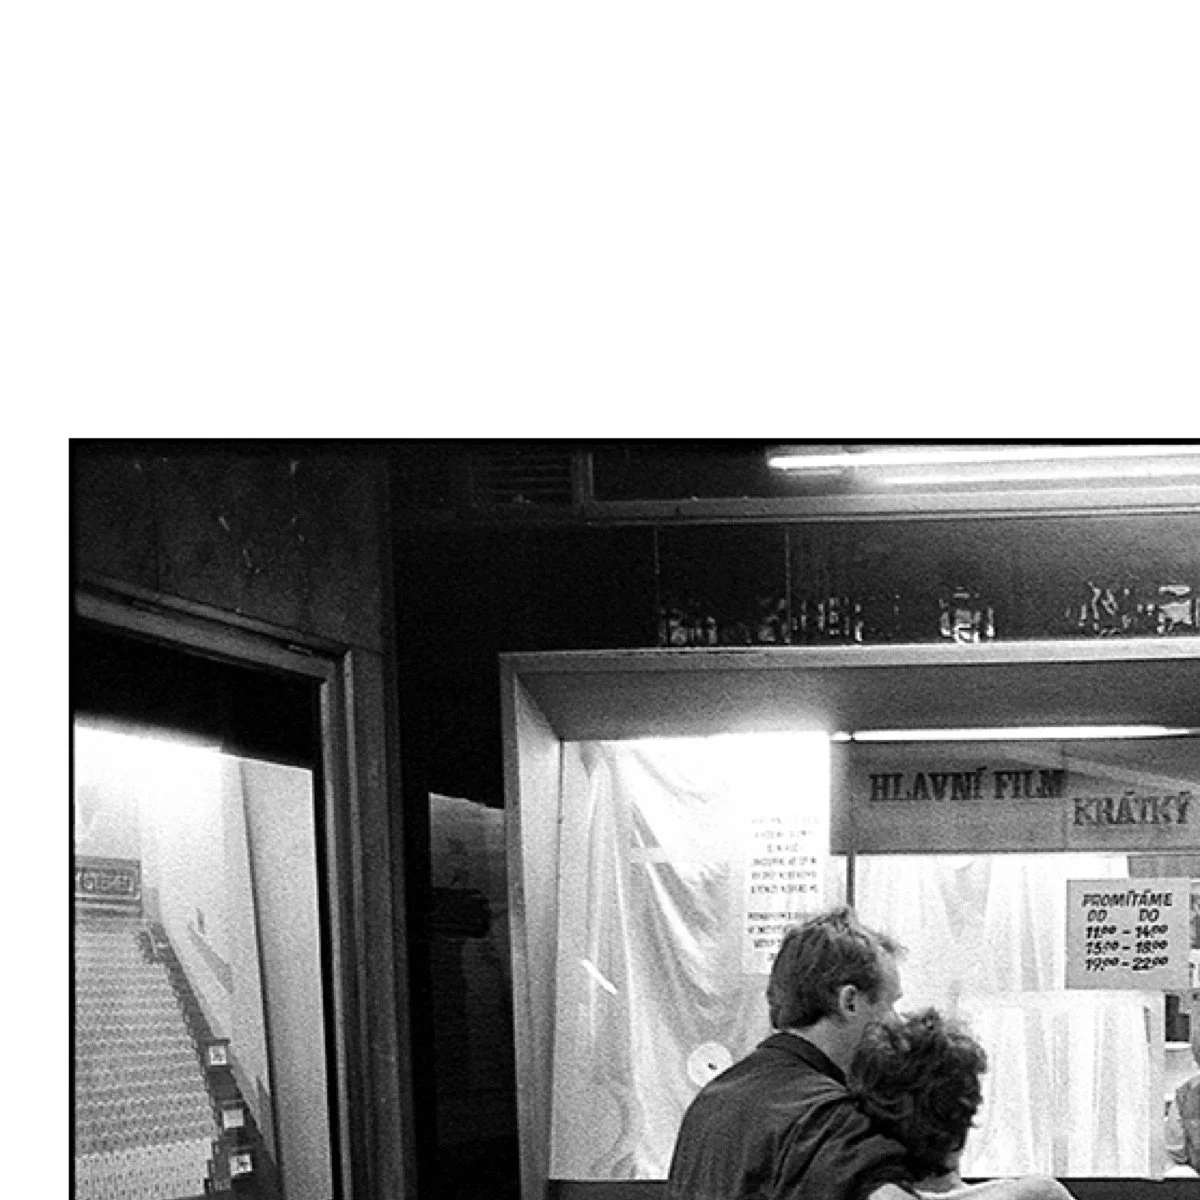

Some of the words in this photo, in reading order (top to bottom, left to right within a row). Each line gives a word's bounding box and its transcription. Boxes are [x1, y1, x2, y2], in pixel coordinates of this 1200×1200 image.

[869, 766, 988, 801] HLAVNÍ
[993, 769, 1067, 799] FILM
[1073, 791, 1192, 826] KRÁTKÝ
[1082, 888, 1172, 908] PROMÍTÁME
[1088, 910, 1107, 922] OD
[1140, 910, 1160, 922] DO
